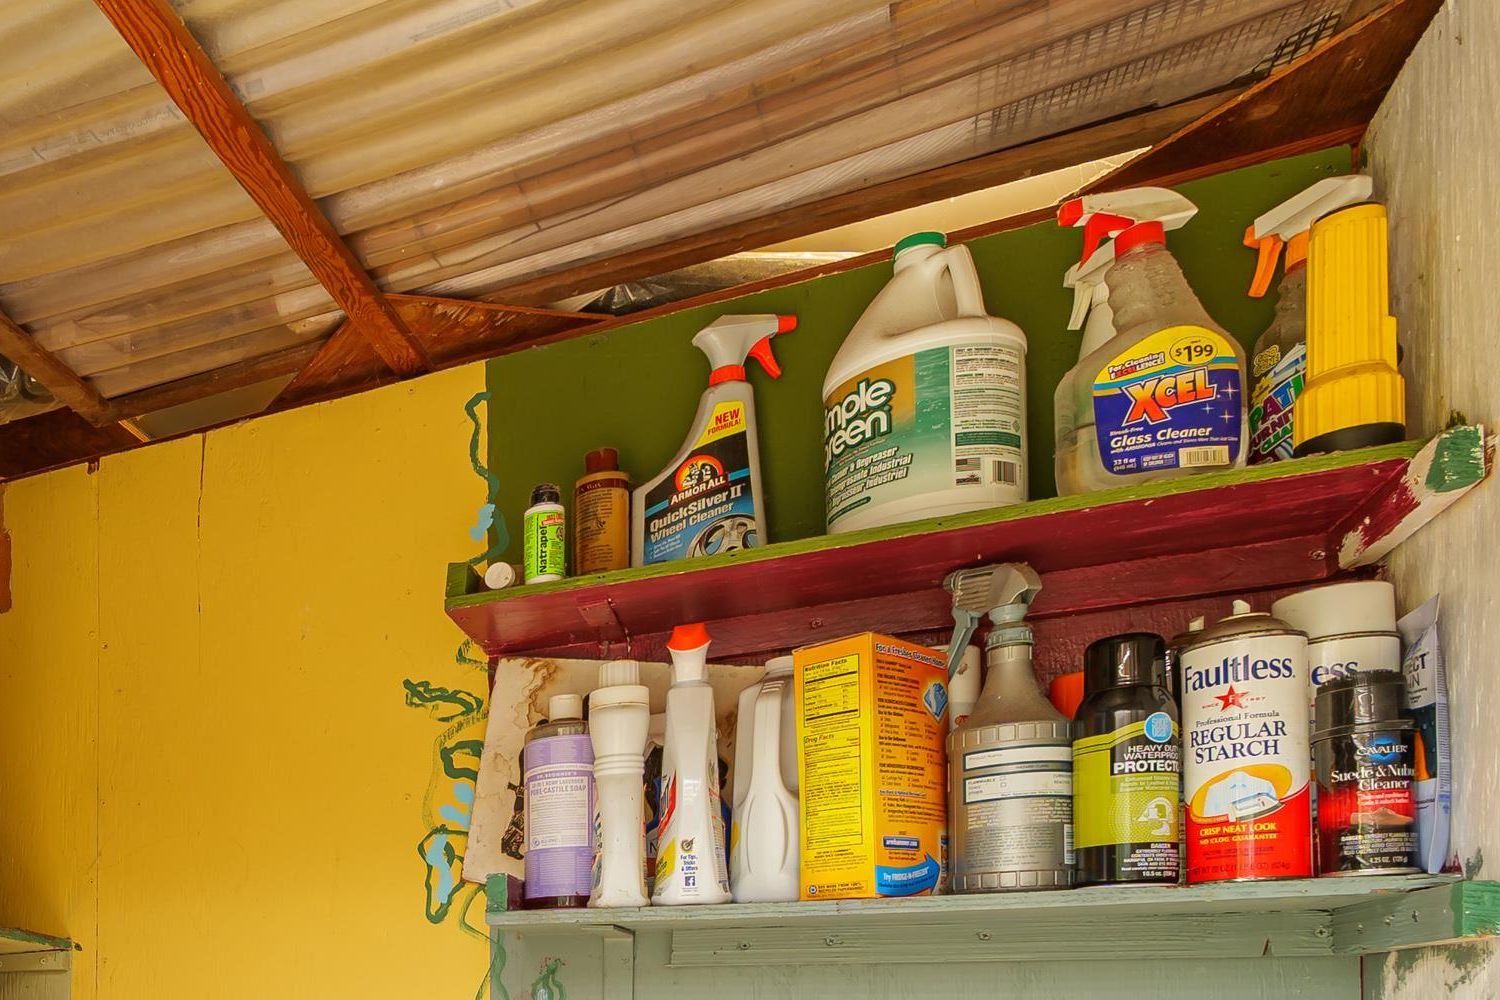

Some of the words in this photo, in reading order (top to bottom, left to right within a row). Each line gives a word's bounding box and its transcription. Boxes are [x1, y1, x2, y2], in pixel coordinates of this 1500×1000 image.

[1122, 366, 1218, 427] XCEL
[715, 408, 740, 426] NEW
[707, 418, 742, 436] FORMULA!
[1110, 433, 1152, 448] Glass
[1156, 427, 1213, 441] Cleaner
[856, 446, 898, 468] Degreaser
[670, 484, 706, 505] ARMOR
[707, 475, 726, 490] ALL
[650, 489, 728, 533] QuickSilver
[650, 518, 687, 544] Wheel
[689, 501, 734, 527] Cleaner
[539, 525, 549, 574] Natrapel
[804, 662, 830, 672] Nutrition
[831, 658, 848, 666] Facts
[1185, 654, 1293, 694] Faultless
[1195, 713, 1242, 728] Professional
[1244, 709, 1280, 719] Formula
[1190, 720, 1287, 748] REGULAR
[1128, 745, 1162, 753] HEAVY
[1195, 739, 1280, 764] STARCH
[1356, 744, 1408, 756] CAVALIER
[1331, 766, 1374, 783] Suede
[1375, 765, 1387, 777] &
[571, 784, 587, 793] SOAP
[1359, 779, 1409, 791] Cleaner
[1199, 825, 1221, 837] CRISP
[1222, 824, 1246, 834] NEAT
[1249, 822, 1277, 832] LOOK
[883, 872, 891, 882] Try
